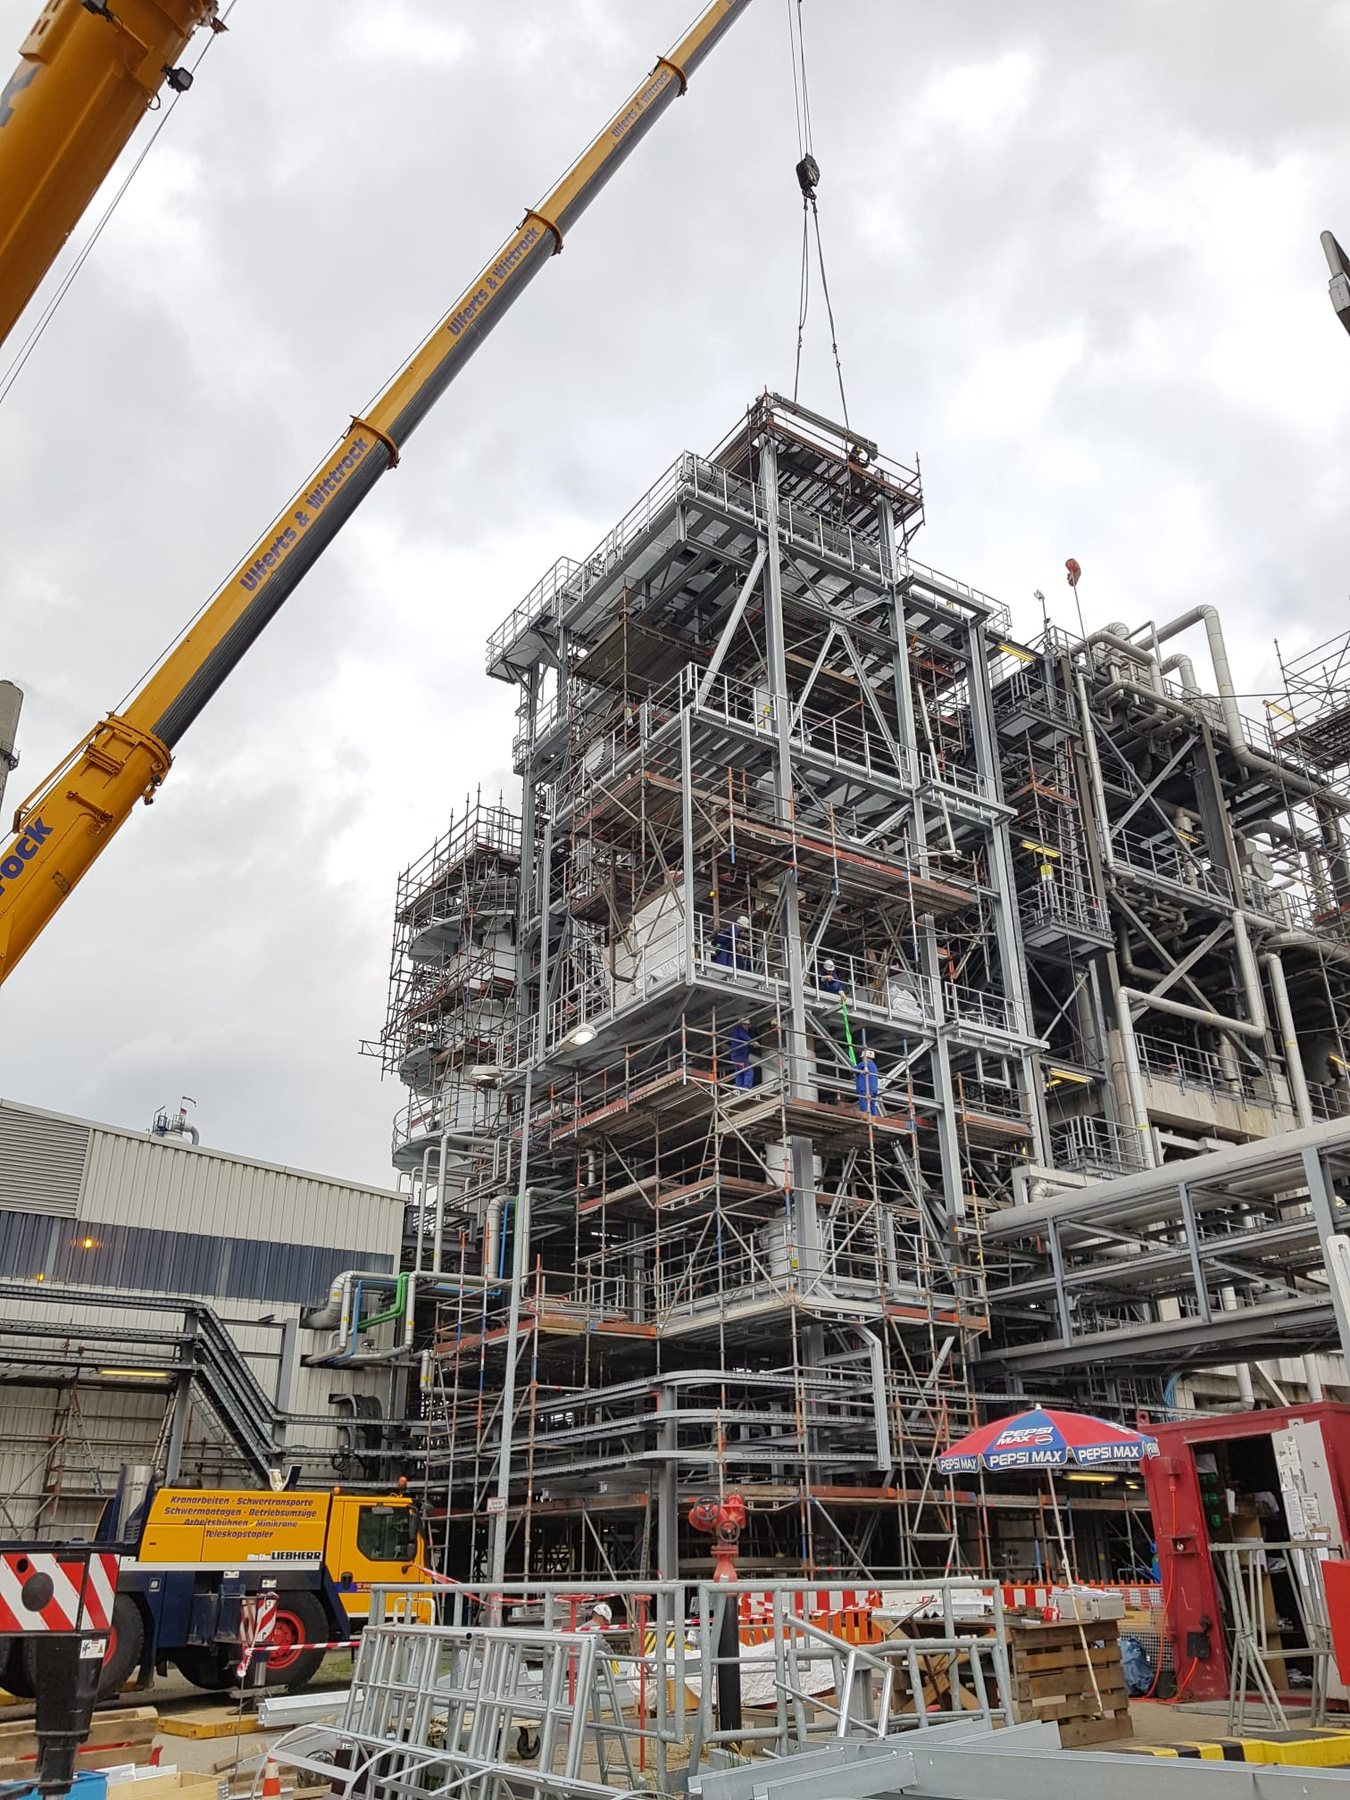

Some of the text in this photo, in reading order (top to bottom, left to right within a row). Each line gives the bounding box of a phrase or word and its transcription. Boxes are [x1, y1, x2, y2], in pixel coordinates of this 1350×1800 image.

[447, 227, 540, 336] Ulferts & Wittrock
[239, 437, 369, 591] Ulferts & Wittrock
[1001, 1426, 1054, 1438] PEPSI
[996, 1435, 1032, 1445] MAX
[989, 1450, 1063, 1467] PEPSI MAX
[1078, 1446, 1113, 1459] PEPSI
[1113, 1446, 1139, 1458] MAX
[941, 1457, 977, 1471] PEPSI MAX
[170, 1496, 314, 1507] Kranarbeiten Schwertransporte
[164, 1507, 317, 1518] Schwermontagen Betriebsumzüge
[205, 1530, 274, 1539] Teleskopstapler
[271, 1551, 322, 1561] LIEBHERR
